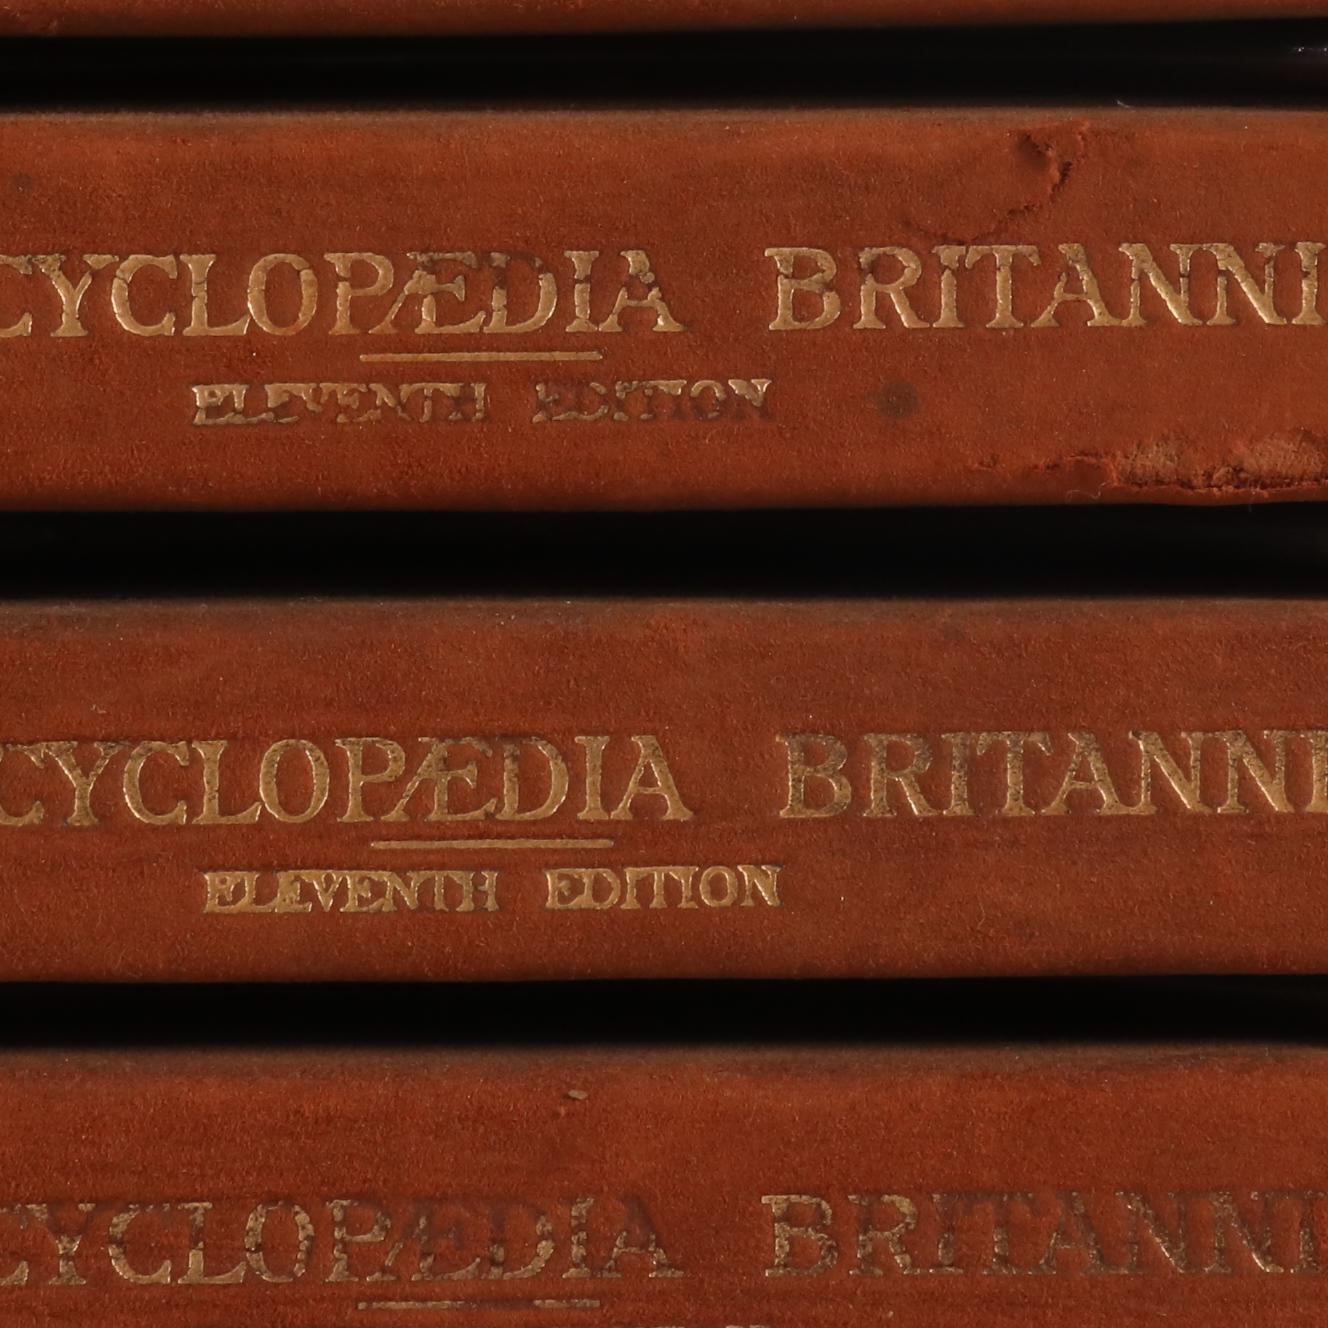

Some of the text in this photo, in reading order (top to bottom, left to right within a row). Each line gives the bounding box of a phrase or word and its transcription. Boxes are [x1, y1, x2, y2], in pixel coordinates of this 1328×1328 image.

[191, 380, 487, 426] ELEVENTH
[202, 864, 782, 915] ELEVENTH EDITION
